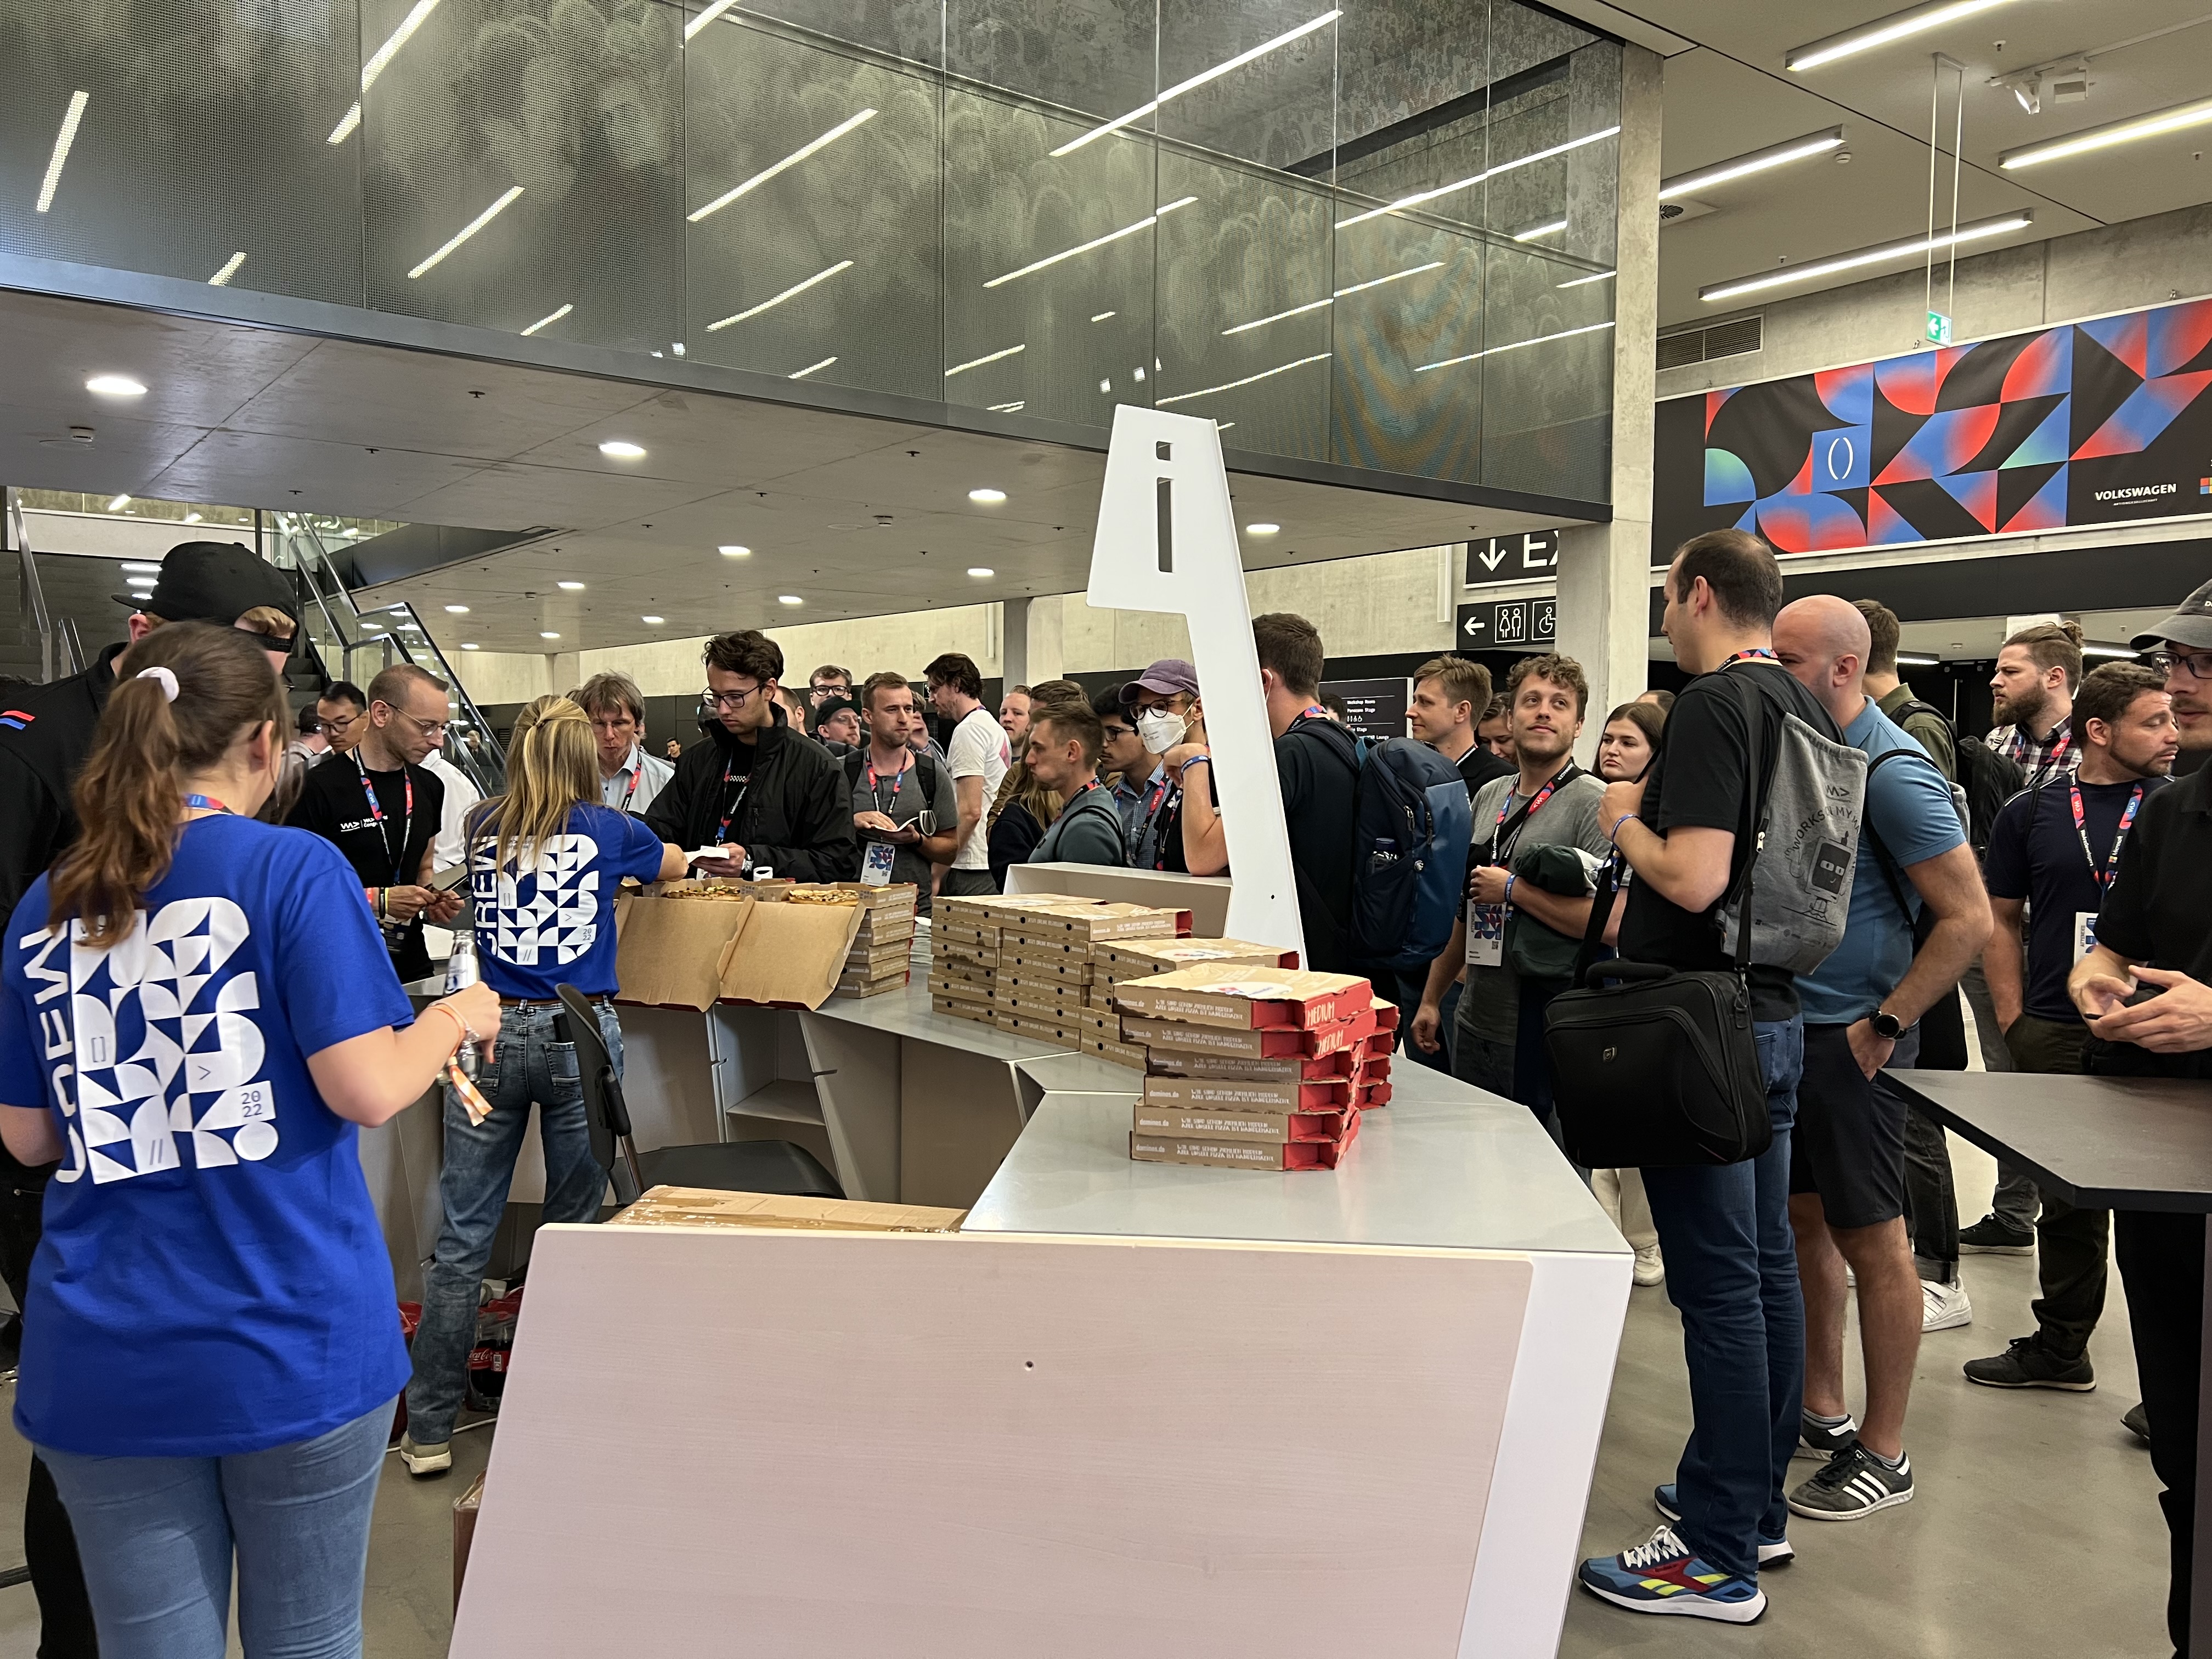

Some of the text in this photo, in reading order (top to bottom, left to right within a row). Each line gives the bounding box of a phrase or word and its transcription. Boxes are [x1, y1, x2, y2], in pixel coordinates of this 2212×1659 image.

[2095, 483, 2176, 501] VOLKSWAGEN
[1793, 810, 1826, 850] WORKS
[1836, 806, 1852, 818] MY
[2080, 829, 2094, 867] WeAreDevelopers
[2113, 836, 2123, 855] Microsoft
[1307, 1001, 1335, 1027] MEDIUM
[1318, 1029, 1344, 1056] MEDIUM
[241, 1091, 262, 1104] 20
[243, 1103, 263, 1117] 22
[1139, 1118, 1169, 1126] dominos.de
